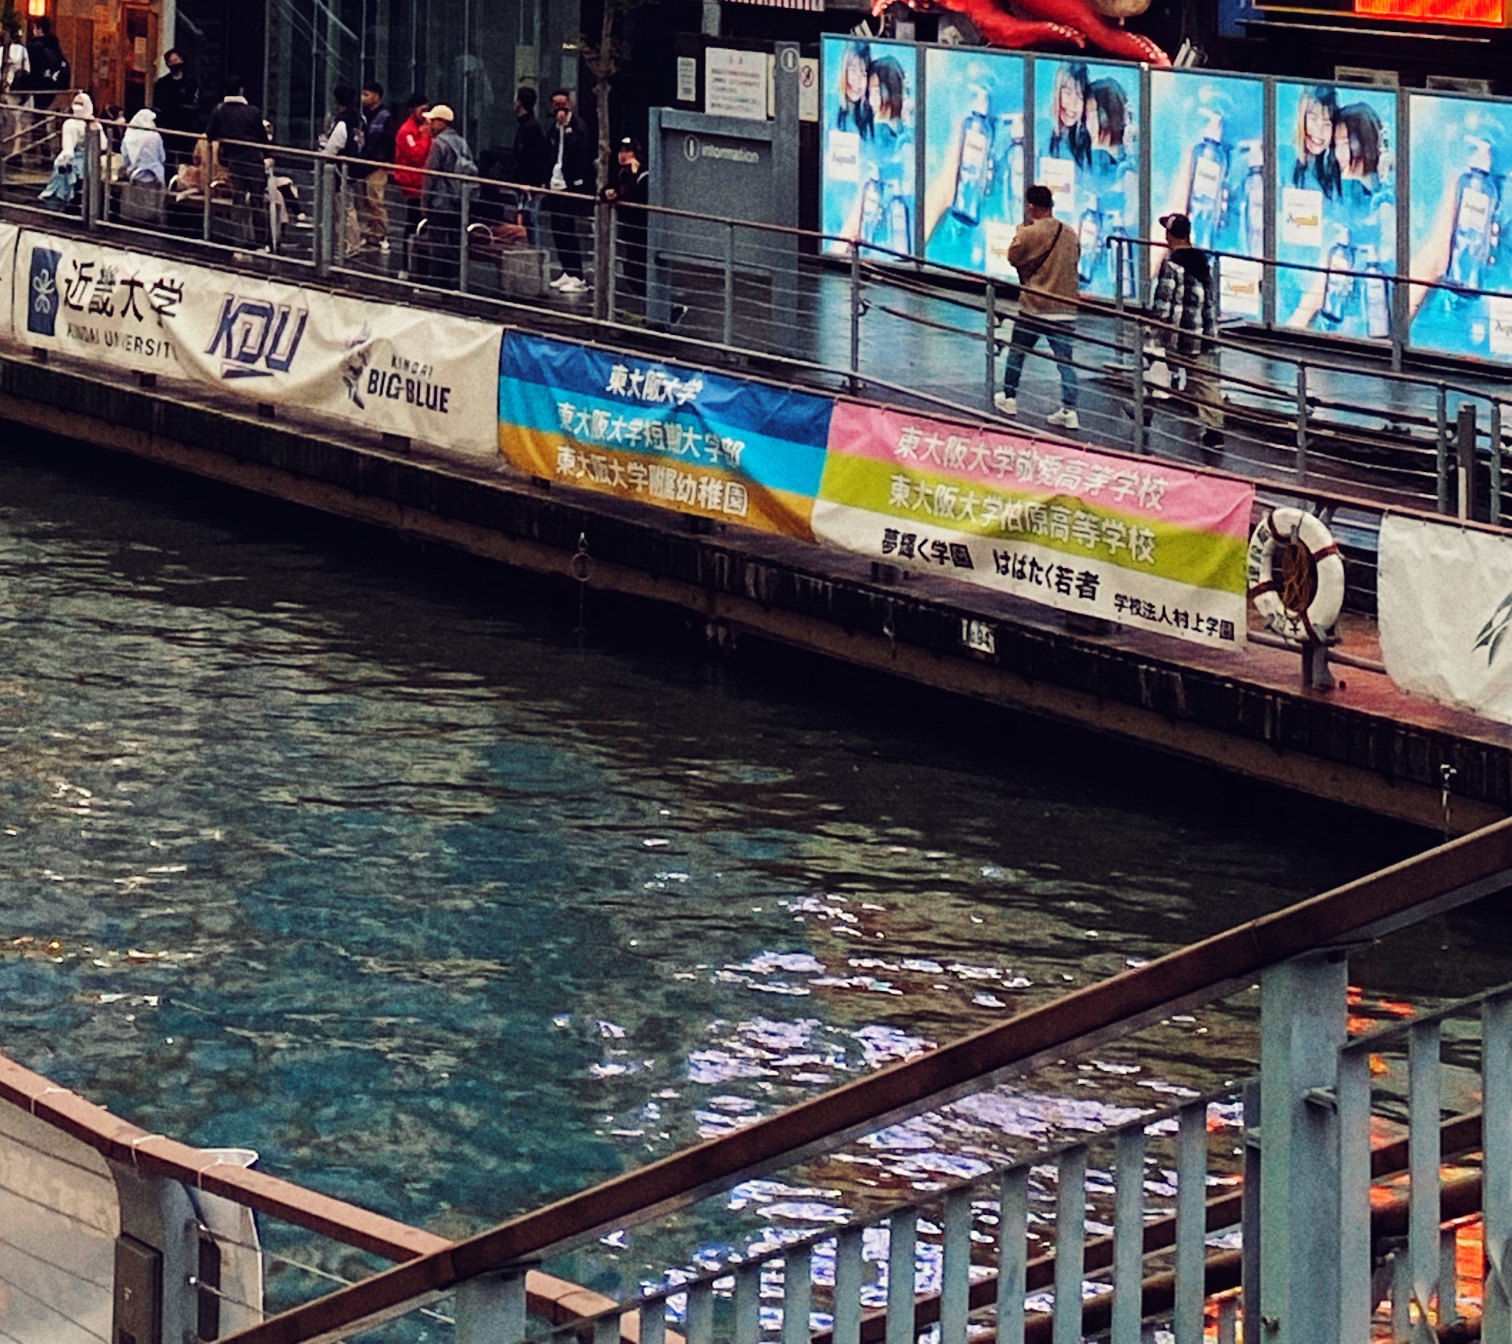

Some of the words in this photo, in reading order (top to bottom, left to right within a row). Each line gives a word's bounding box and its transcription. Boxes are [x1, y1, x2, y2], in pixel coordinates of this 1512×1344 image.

[63, 259, 186, 327] 近畿大学
[366, 367, 404, 400] BIG
[405, 374, 452, 415] BLUE
[605, 363, 704, 405] 東大阪大学
[556, 401, 745, 467] 東大阪大学短期大学部
[895, 424, 1170, 511] 東大阪大学敬愛高等学校
[889, 473, 1158, 566] 東大阪大学柏原高等学校
[881, 527, 974, 571] 夢輝く学園
[992, 548, 1100, 601] はばたく若者
[1113, 593, 1236, 642] 学校法人村上学園
